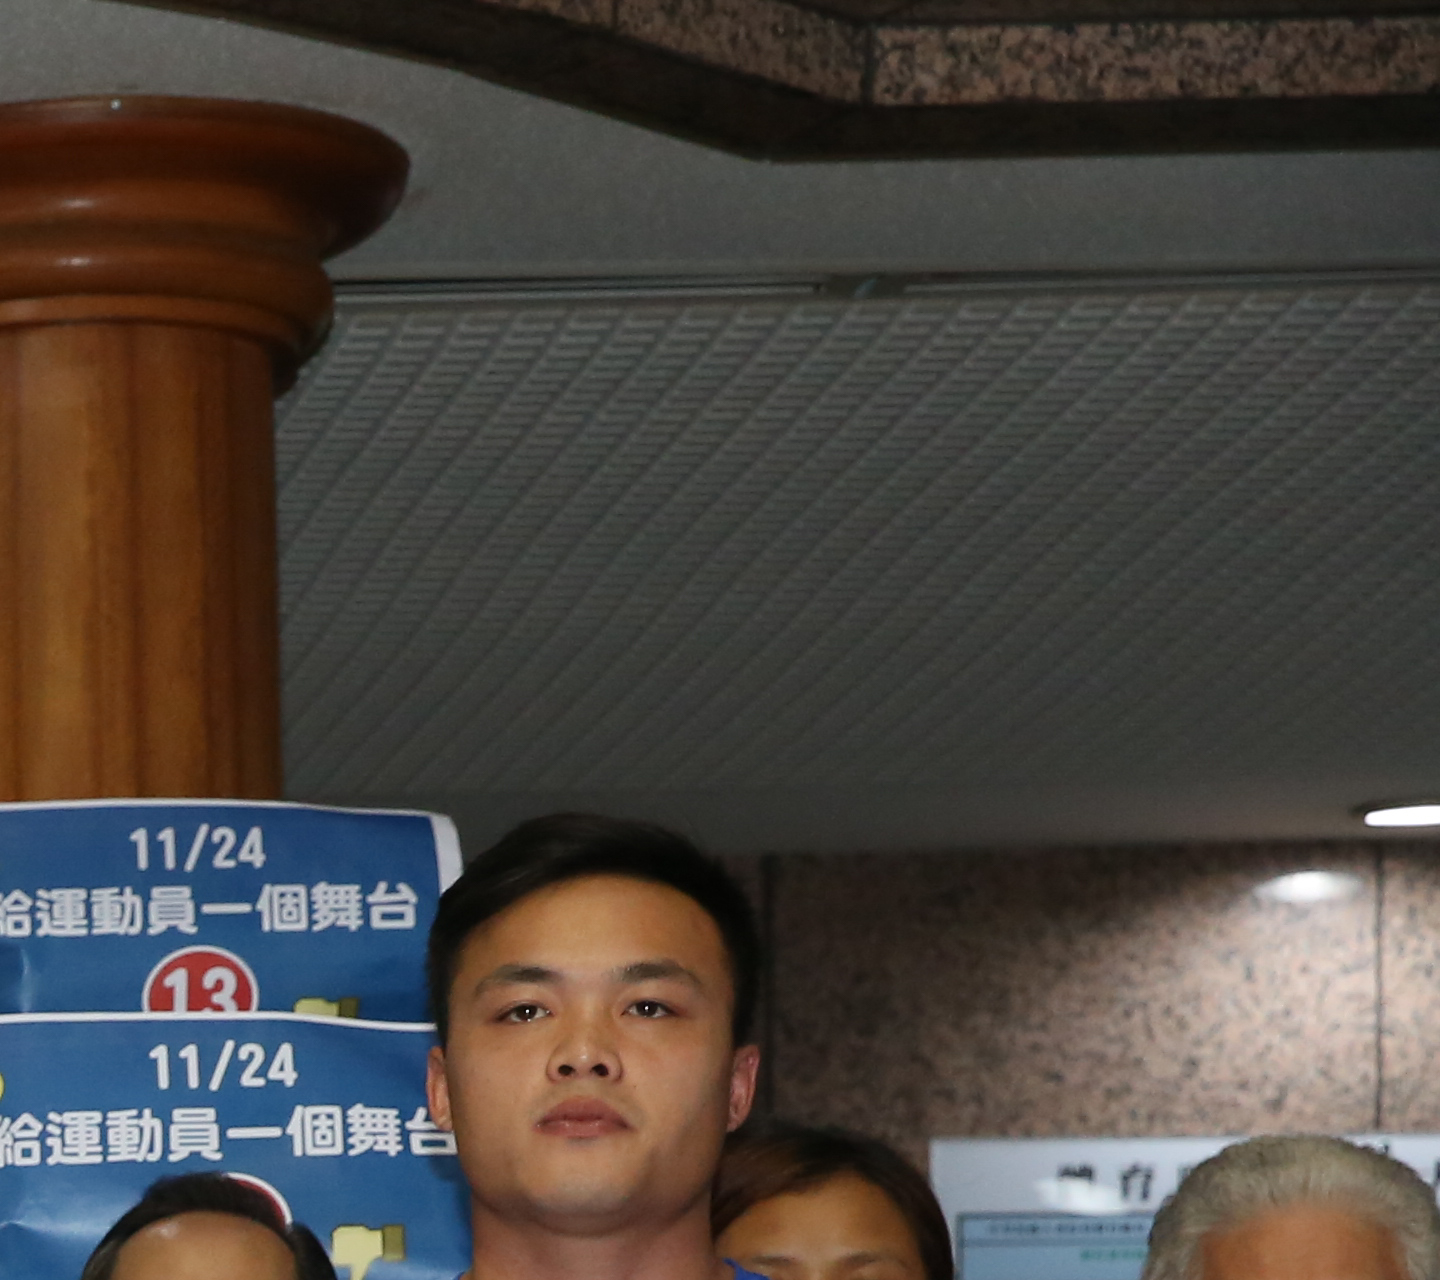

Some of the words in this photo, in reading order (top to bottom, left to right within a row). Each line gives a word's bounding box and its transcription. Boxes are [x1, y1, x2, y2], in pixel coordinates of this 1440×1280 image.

[129, 824, 267, 873] 11/24
[160, 965, 236, 1012] 13
[149, 1041, 299, 1092] 11/24
